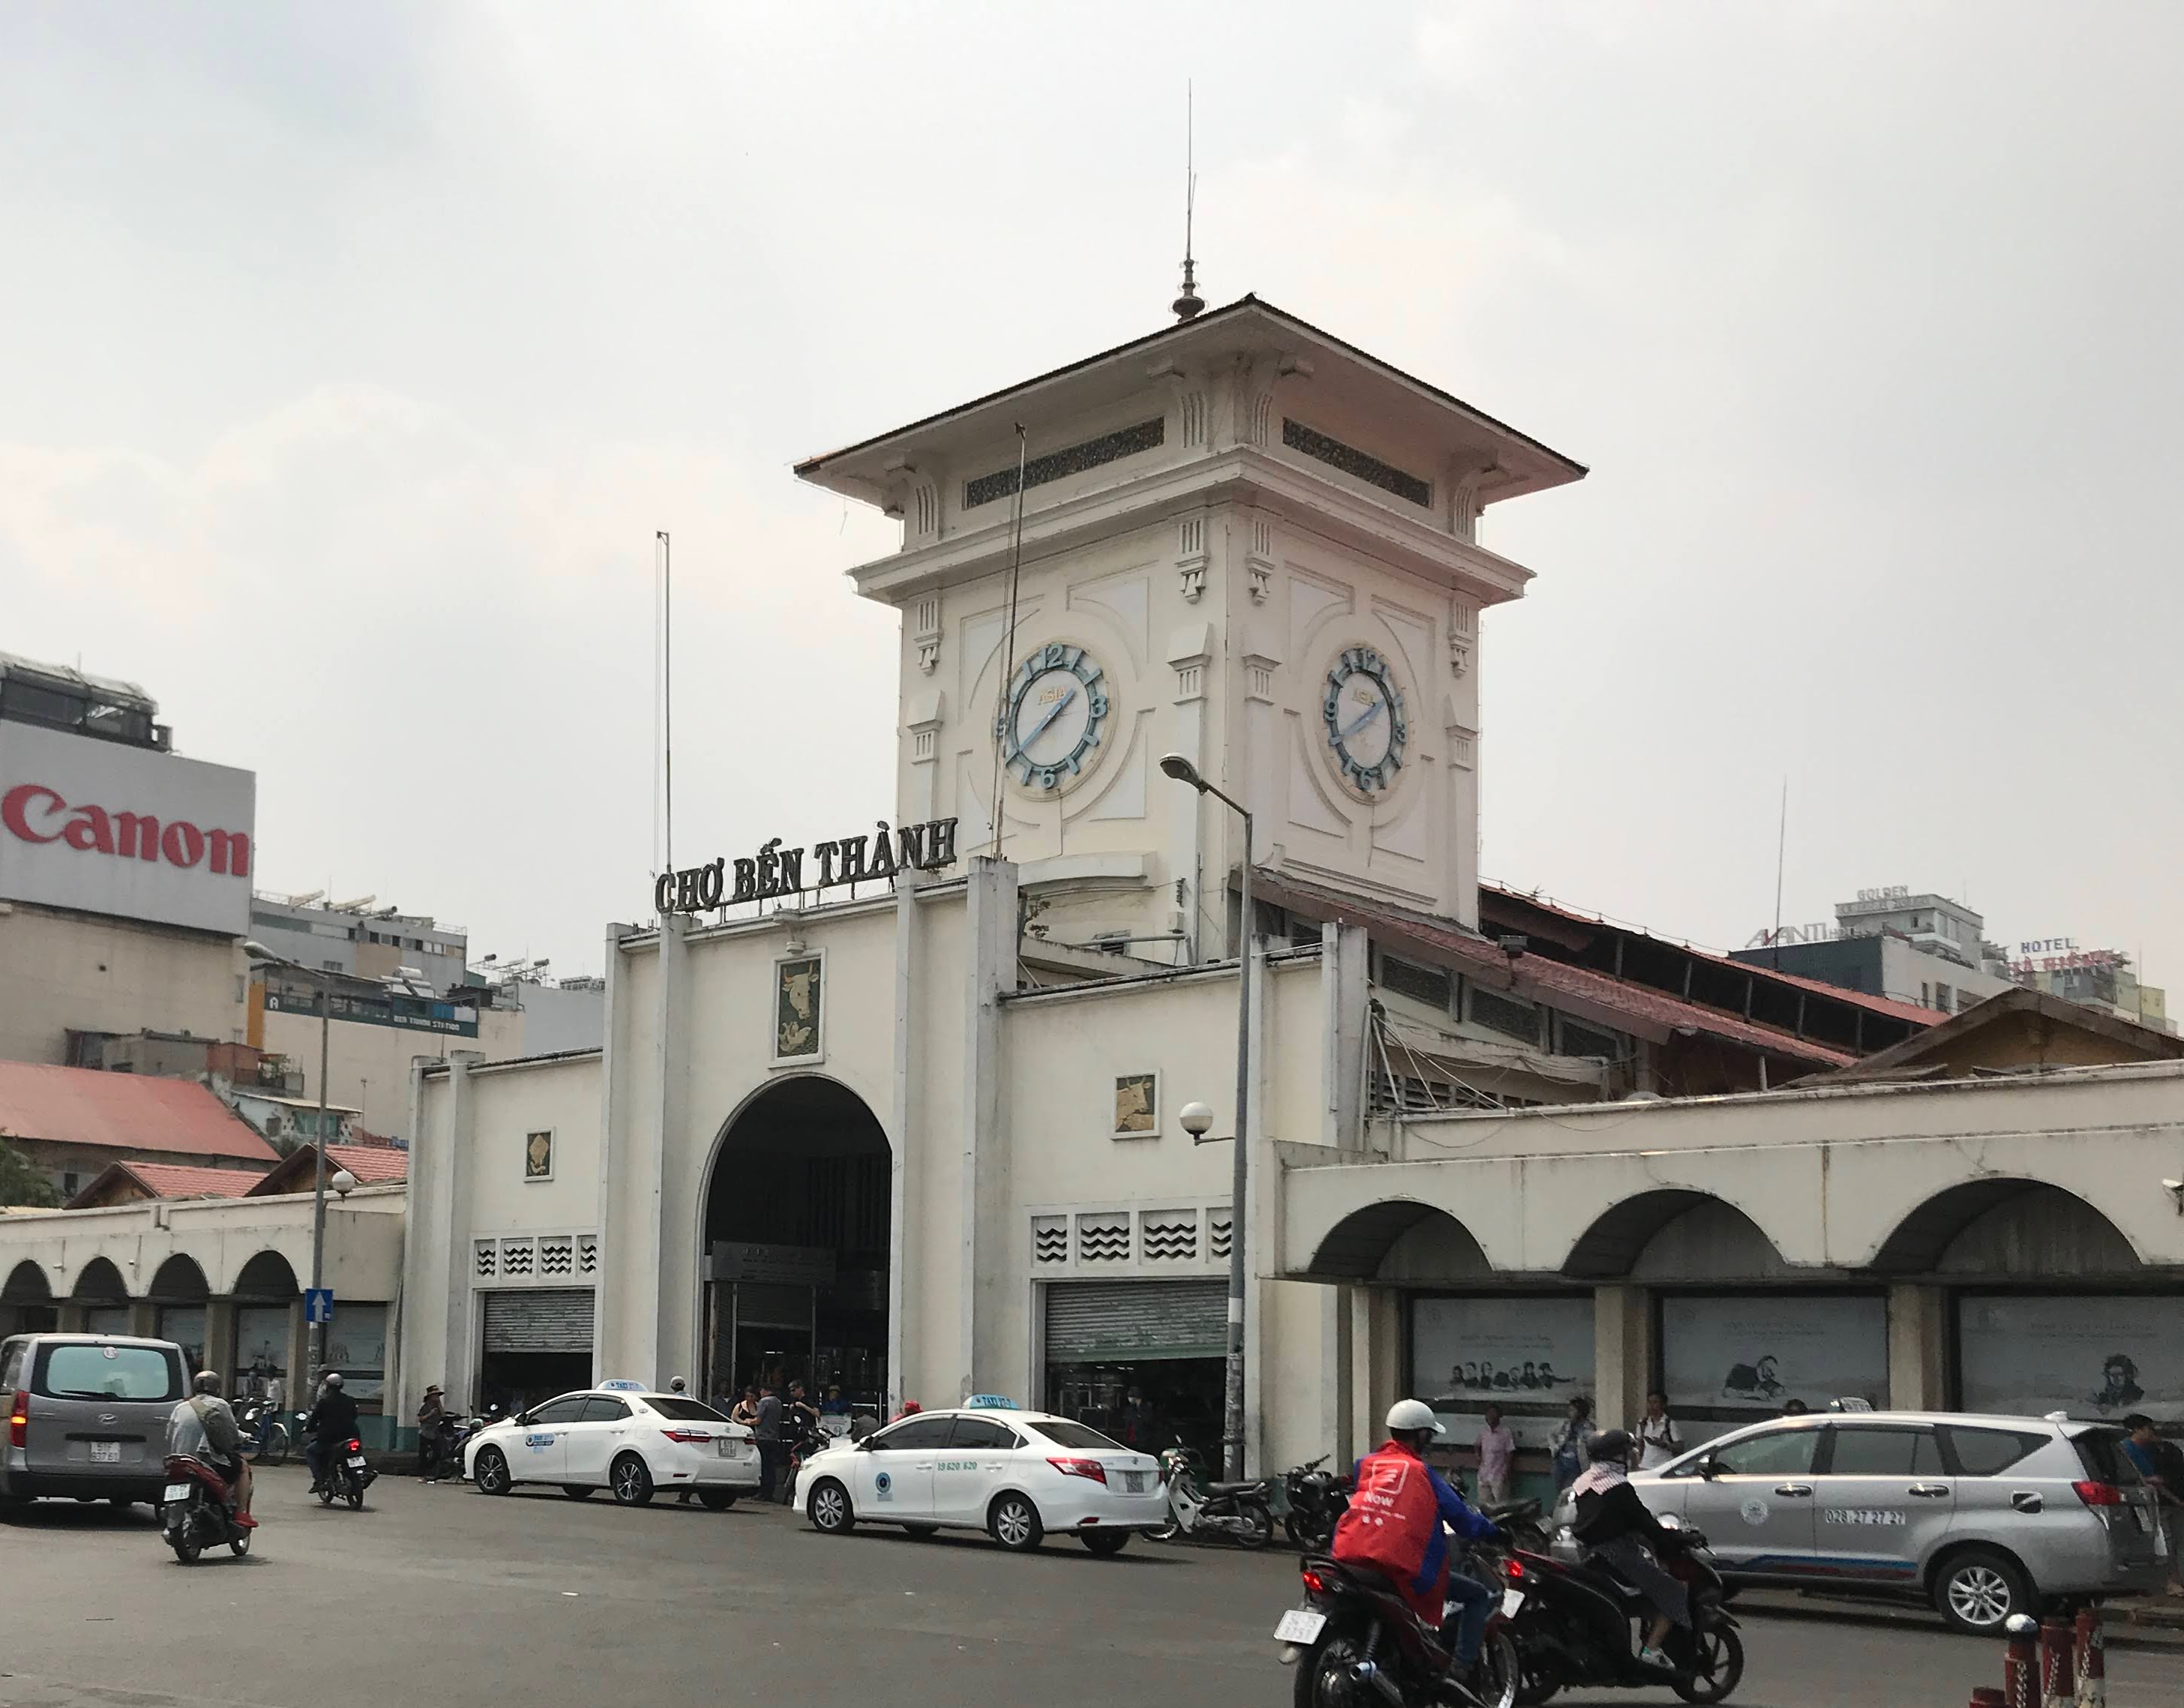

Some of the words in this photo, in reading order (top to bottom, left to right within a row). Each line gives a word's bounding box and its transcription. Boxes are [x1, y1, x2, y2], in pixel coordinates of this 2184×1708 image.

[1090, 694, 1107, 718] 3
[1, 783, 250, 877] Canon
[655, 857, 725, 915] CHỢ
[732, 838, 804, 902] BẾN
[814, 817, 959, 888] THÀNH
[1856, 885, 1909, 900] GOLDEN
[1745, 923, 1827, 948] AVANTI
[2021, 937, 2078, 954] HOTEL
[982, 1396, 998, 1407] TAXI
